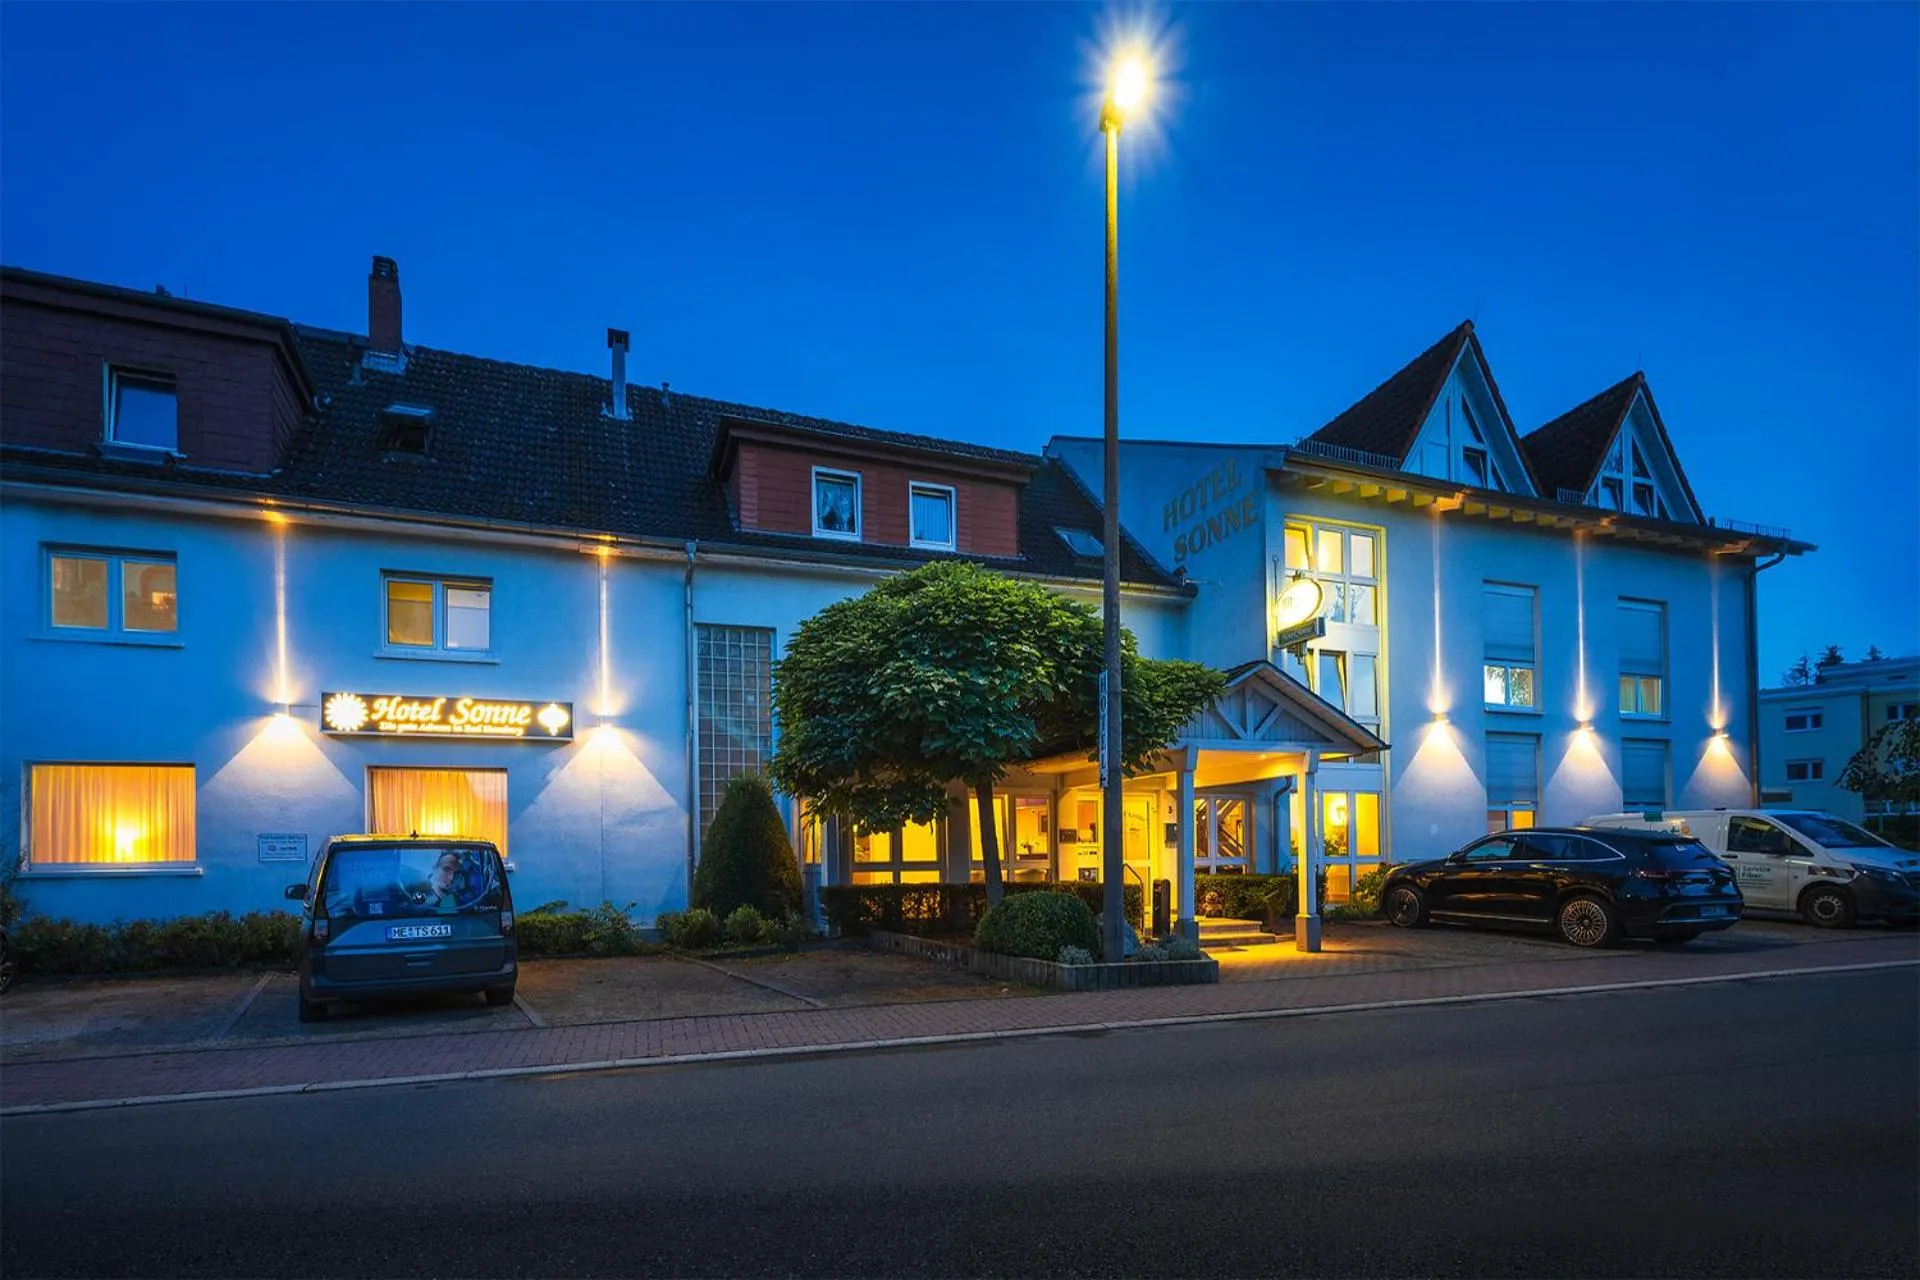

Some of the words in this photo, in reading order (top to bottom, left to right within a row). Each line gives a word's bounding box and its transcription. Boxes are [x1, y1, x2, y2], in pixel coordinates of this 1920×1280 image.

[1163, 457, 1240, 533] HOTEL
[1174, 495, 1260, 563] SONNE
[371, 696, 446, 721] Hotel
[449, 696, 531, 724] Sonne
